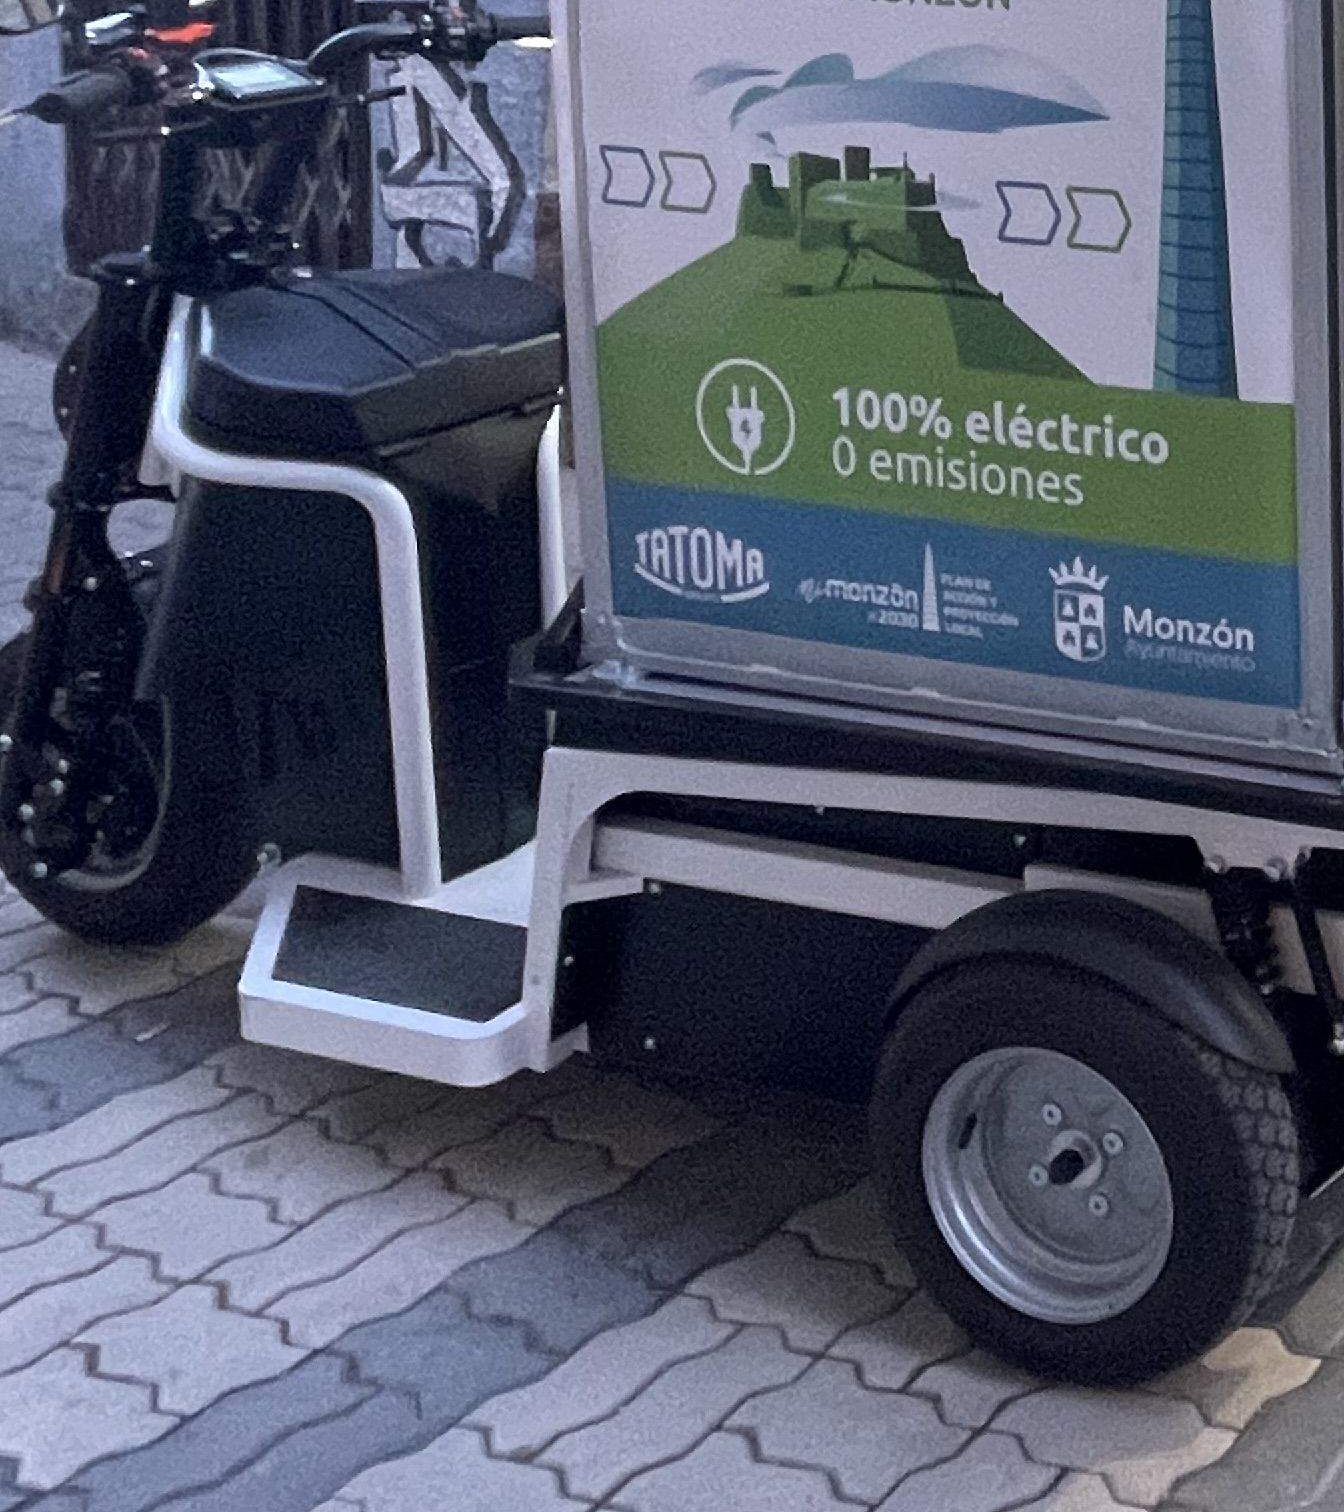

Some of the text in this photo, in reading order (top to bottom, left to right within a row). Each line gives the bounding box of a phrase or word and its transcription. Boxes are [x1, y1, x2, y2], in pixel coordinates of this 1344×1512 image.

[832, 386, 1170, 464] 100% eléctrico
[832, 438, 1084, 506] 0 emisiones
[635, 525, 764, 589] TATOMA
[1123, 605, 1254, 652] Monzón
[1123, 639, 1256, 673] Ayuntamiento
